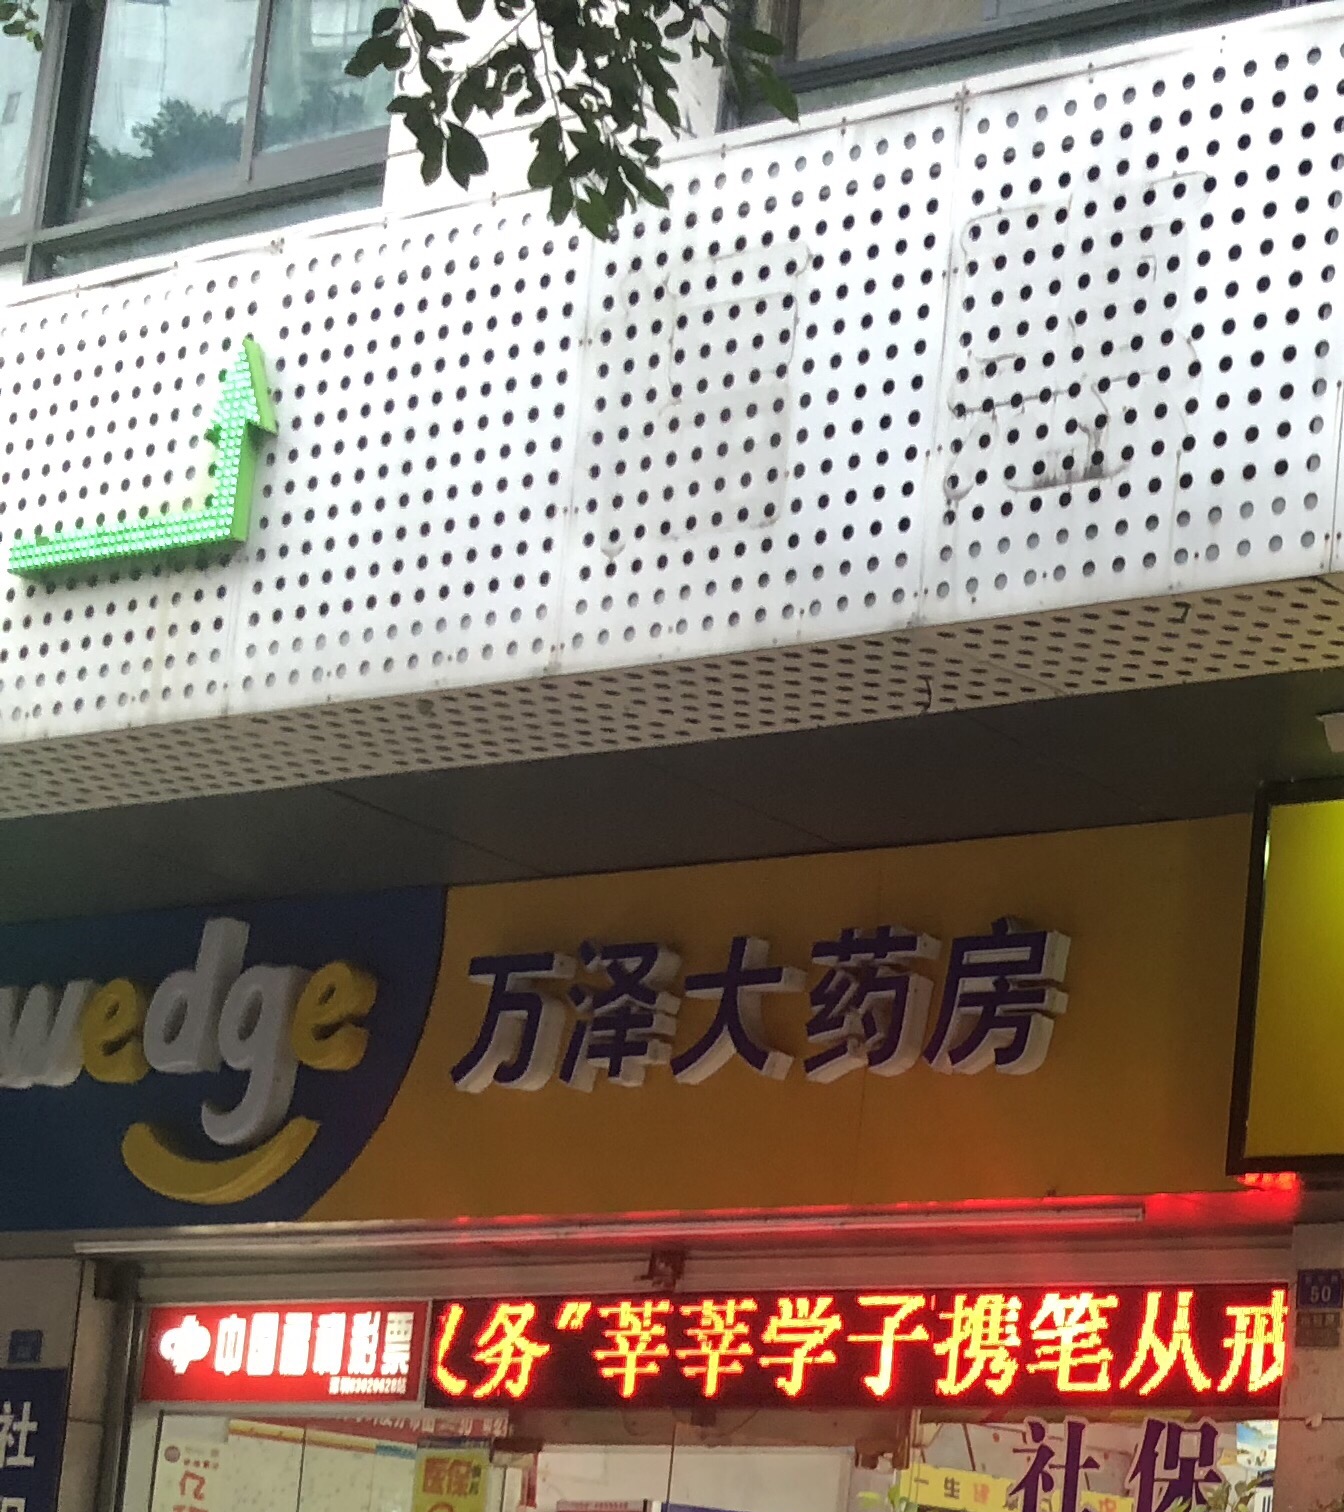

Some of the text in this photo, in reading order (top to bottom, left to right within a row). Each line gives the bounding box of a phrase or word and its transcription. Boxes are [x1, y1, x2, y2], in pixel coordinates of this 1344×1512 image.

[450, 917, 1072, 1093] 万泽大药房
